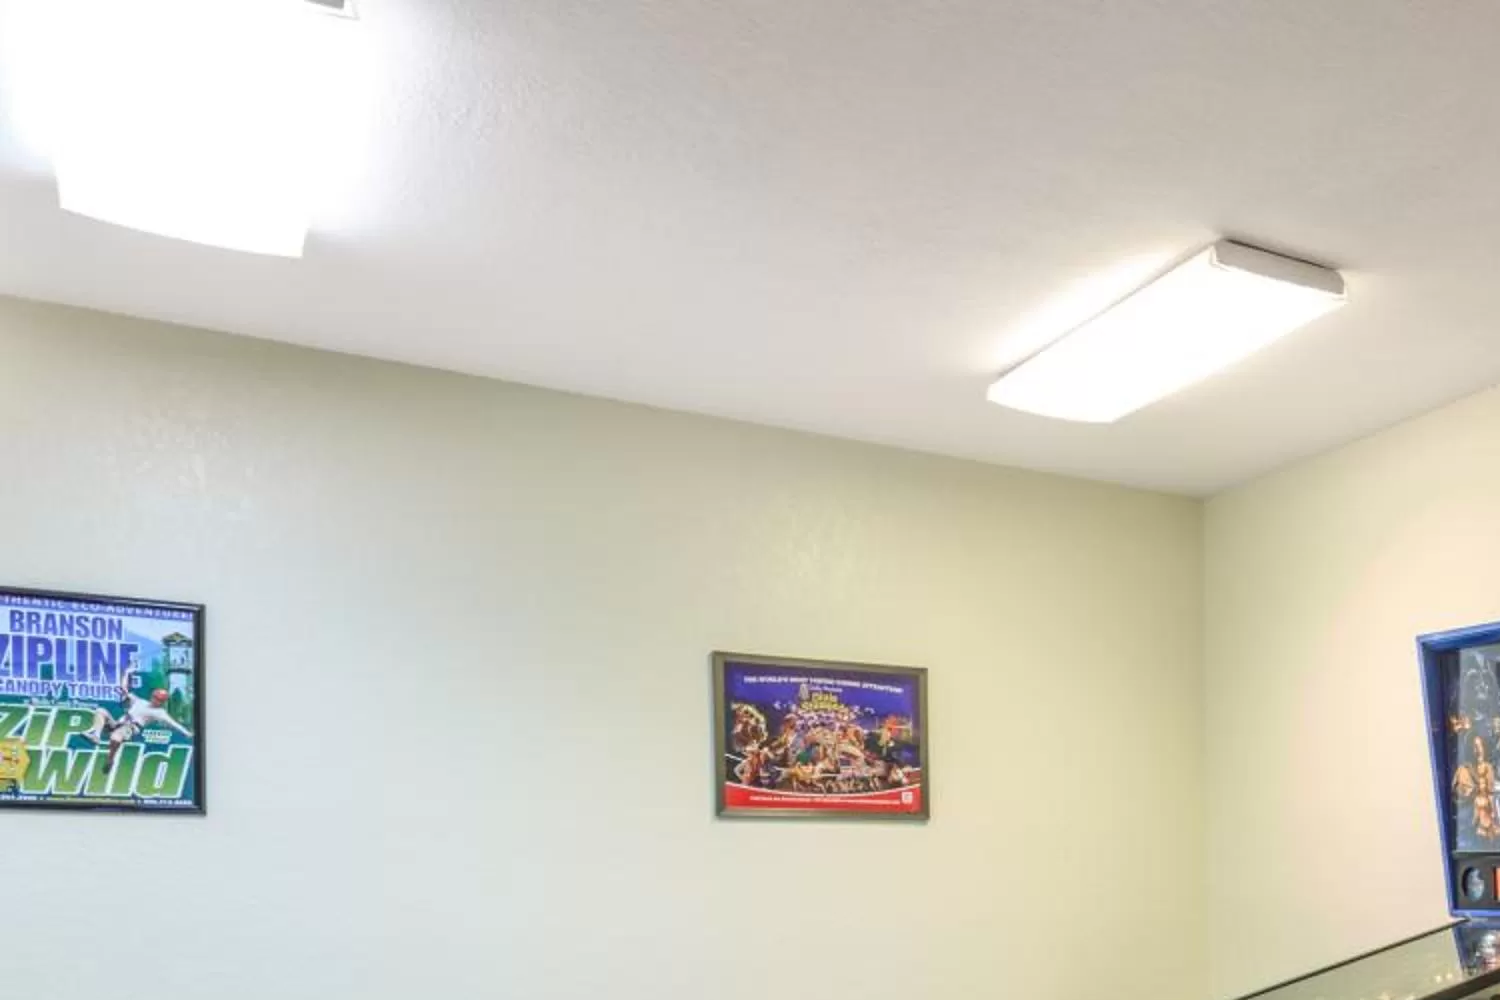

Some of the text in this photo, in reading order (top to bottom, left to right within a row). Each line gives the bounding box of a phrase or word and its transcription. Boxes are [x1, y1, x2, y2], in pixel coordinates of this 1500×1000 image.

[9, 609, 123, 640] BRANSON
[0, 678, 123, 701] ANOPY TOURS
